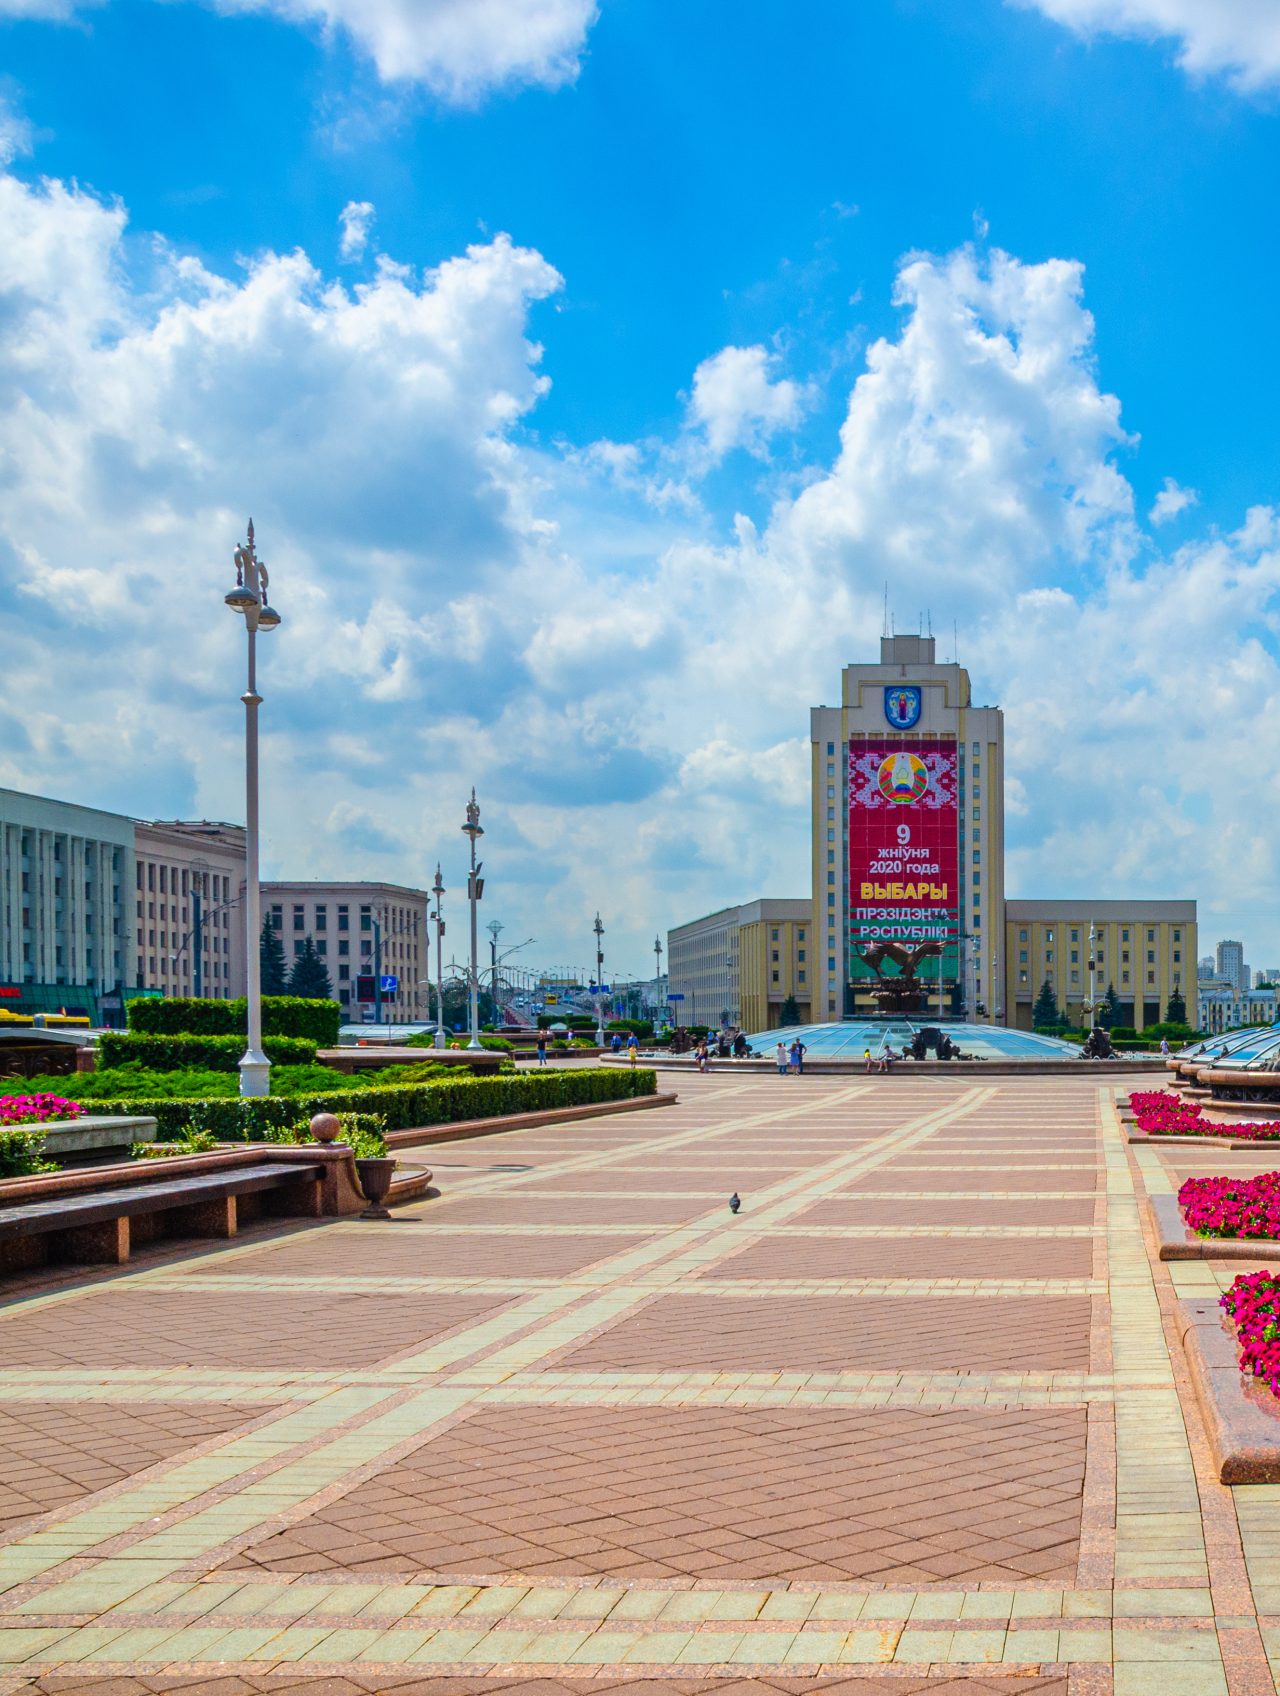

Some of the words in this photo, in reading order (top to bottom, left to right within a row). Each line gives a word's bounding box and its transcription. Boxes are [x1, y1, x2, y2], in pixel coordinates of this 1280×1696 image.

[896, 824, 911, 845] 9
[877, 845, 930, 861] жніўня
[869, 860, 902, 874] 2020
[906, 863, 940, 875] года
[860, 882, 948, 900] ВЫБАРЫ
[860, 925, 948, 938] РЭСПУБЛІКІ
